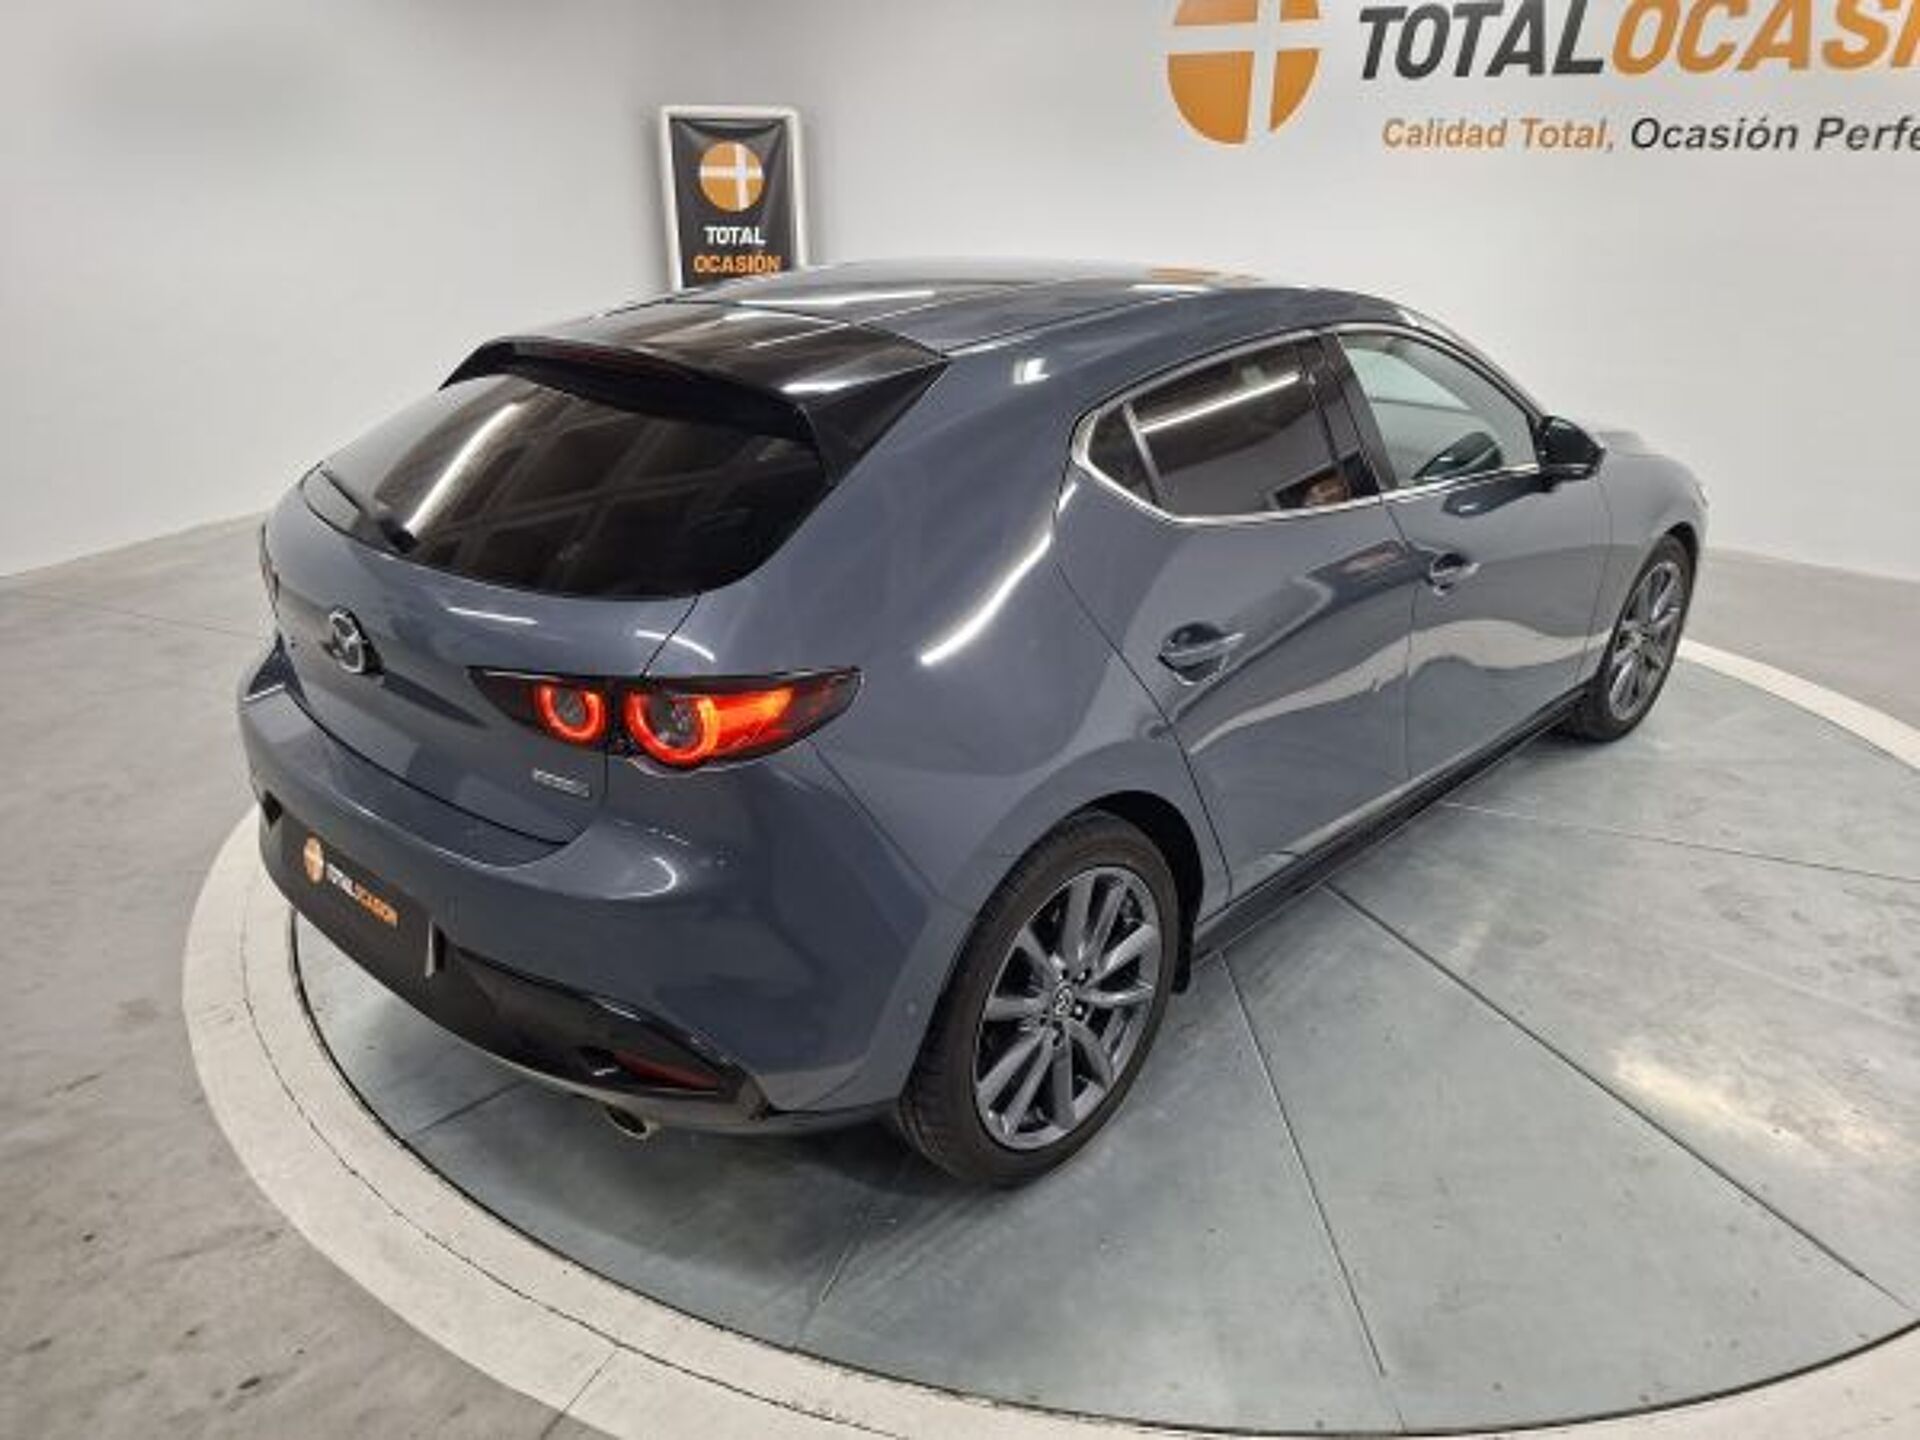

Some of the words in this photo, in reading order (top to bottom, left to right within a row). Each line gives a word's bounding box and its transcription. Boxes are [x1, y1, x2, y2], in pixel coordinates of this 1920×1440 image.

[1382, 118, 1508, 149] Calidad
[1520, 117, 1614, 152] Total,
[1631, 117, 1799, 149] Ocasión
[703, 226, 766, 245] TOTAL
